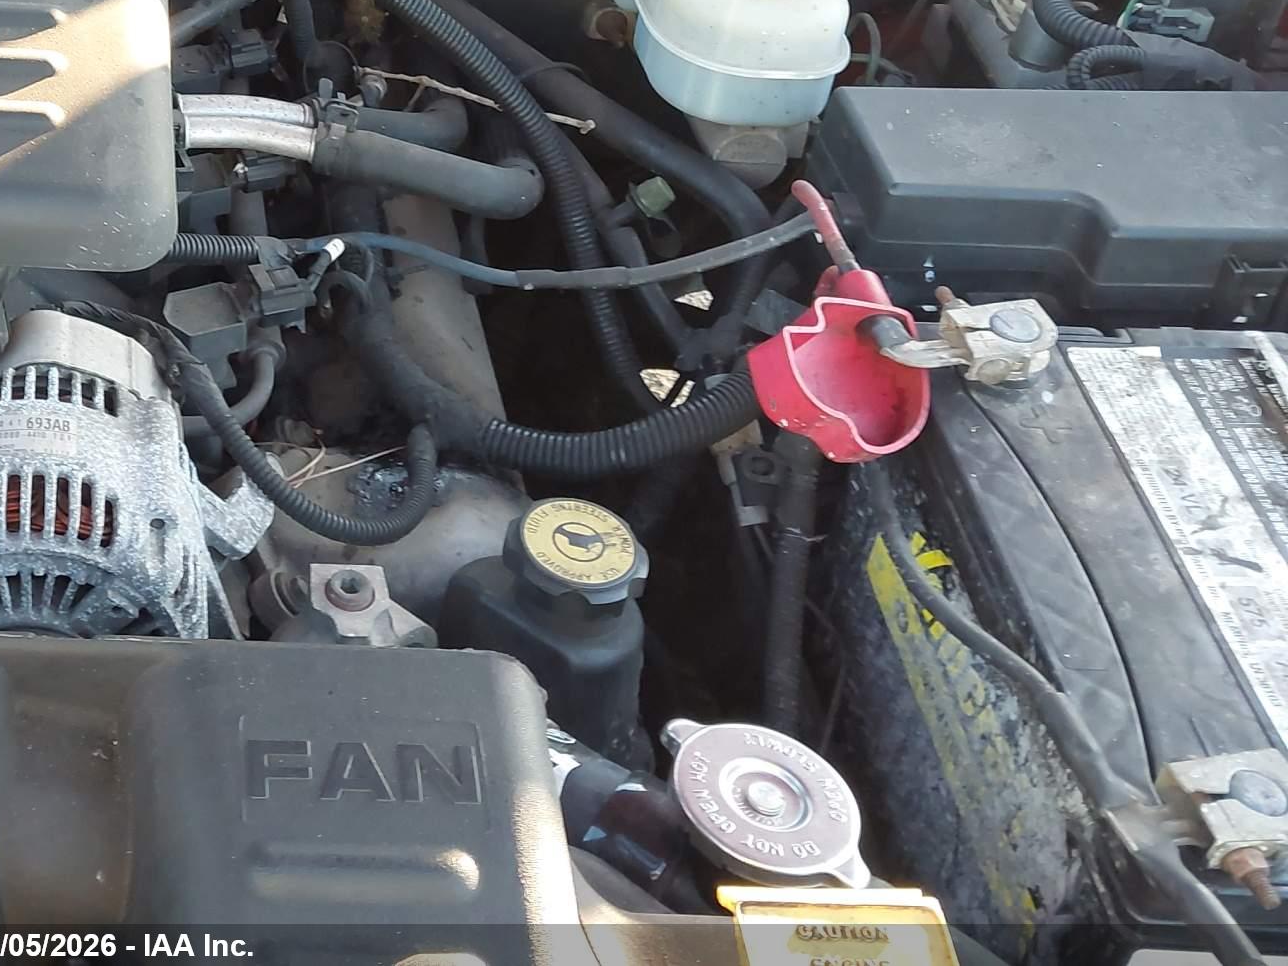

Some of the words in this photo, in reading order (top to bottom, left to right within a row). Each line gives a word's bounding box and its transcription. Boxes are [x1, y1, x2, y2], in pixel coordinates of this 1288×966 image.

[26, 417, 71, 432] 693AB
[526, 508, 550, 534] FLUID
[551, 502, 609, 523] STEERING
[536, 551, 592, 581] APPROVED
[599, 566, 620, 580] USE
[246, 738, 482, 805] FAN
[688, 751, 711, 784] HOT
[691, 788, 737, 835] OPEN
[816, 777, 849, 825] OPEN
[741, 833, 785, 858] NOT
[791, 840, 822, 860] DO
[795, 923, 890, 942] CAUTION
